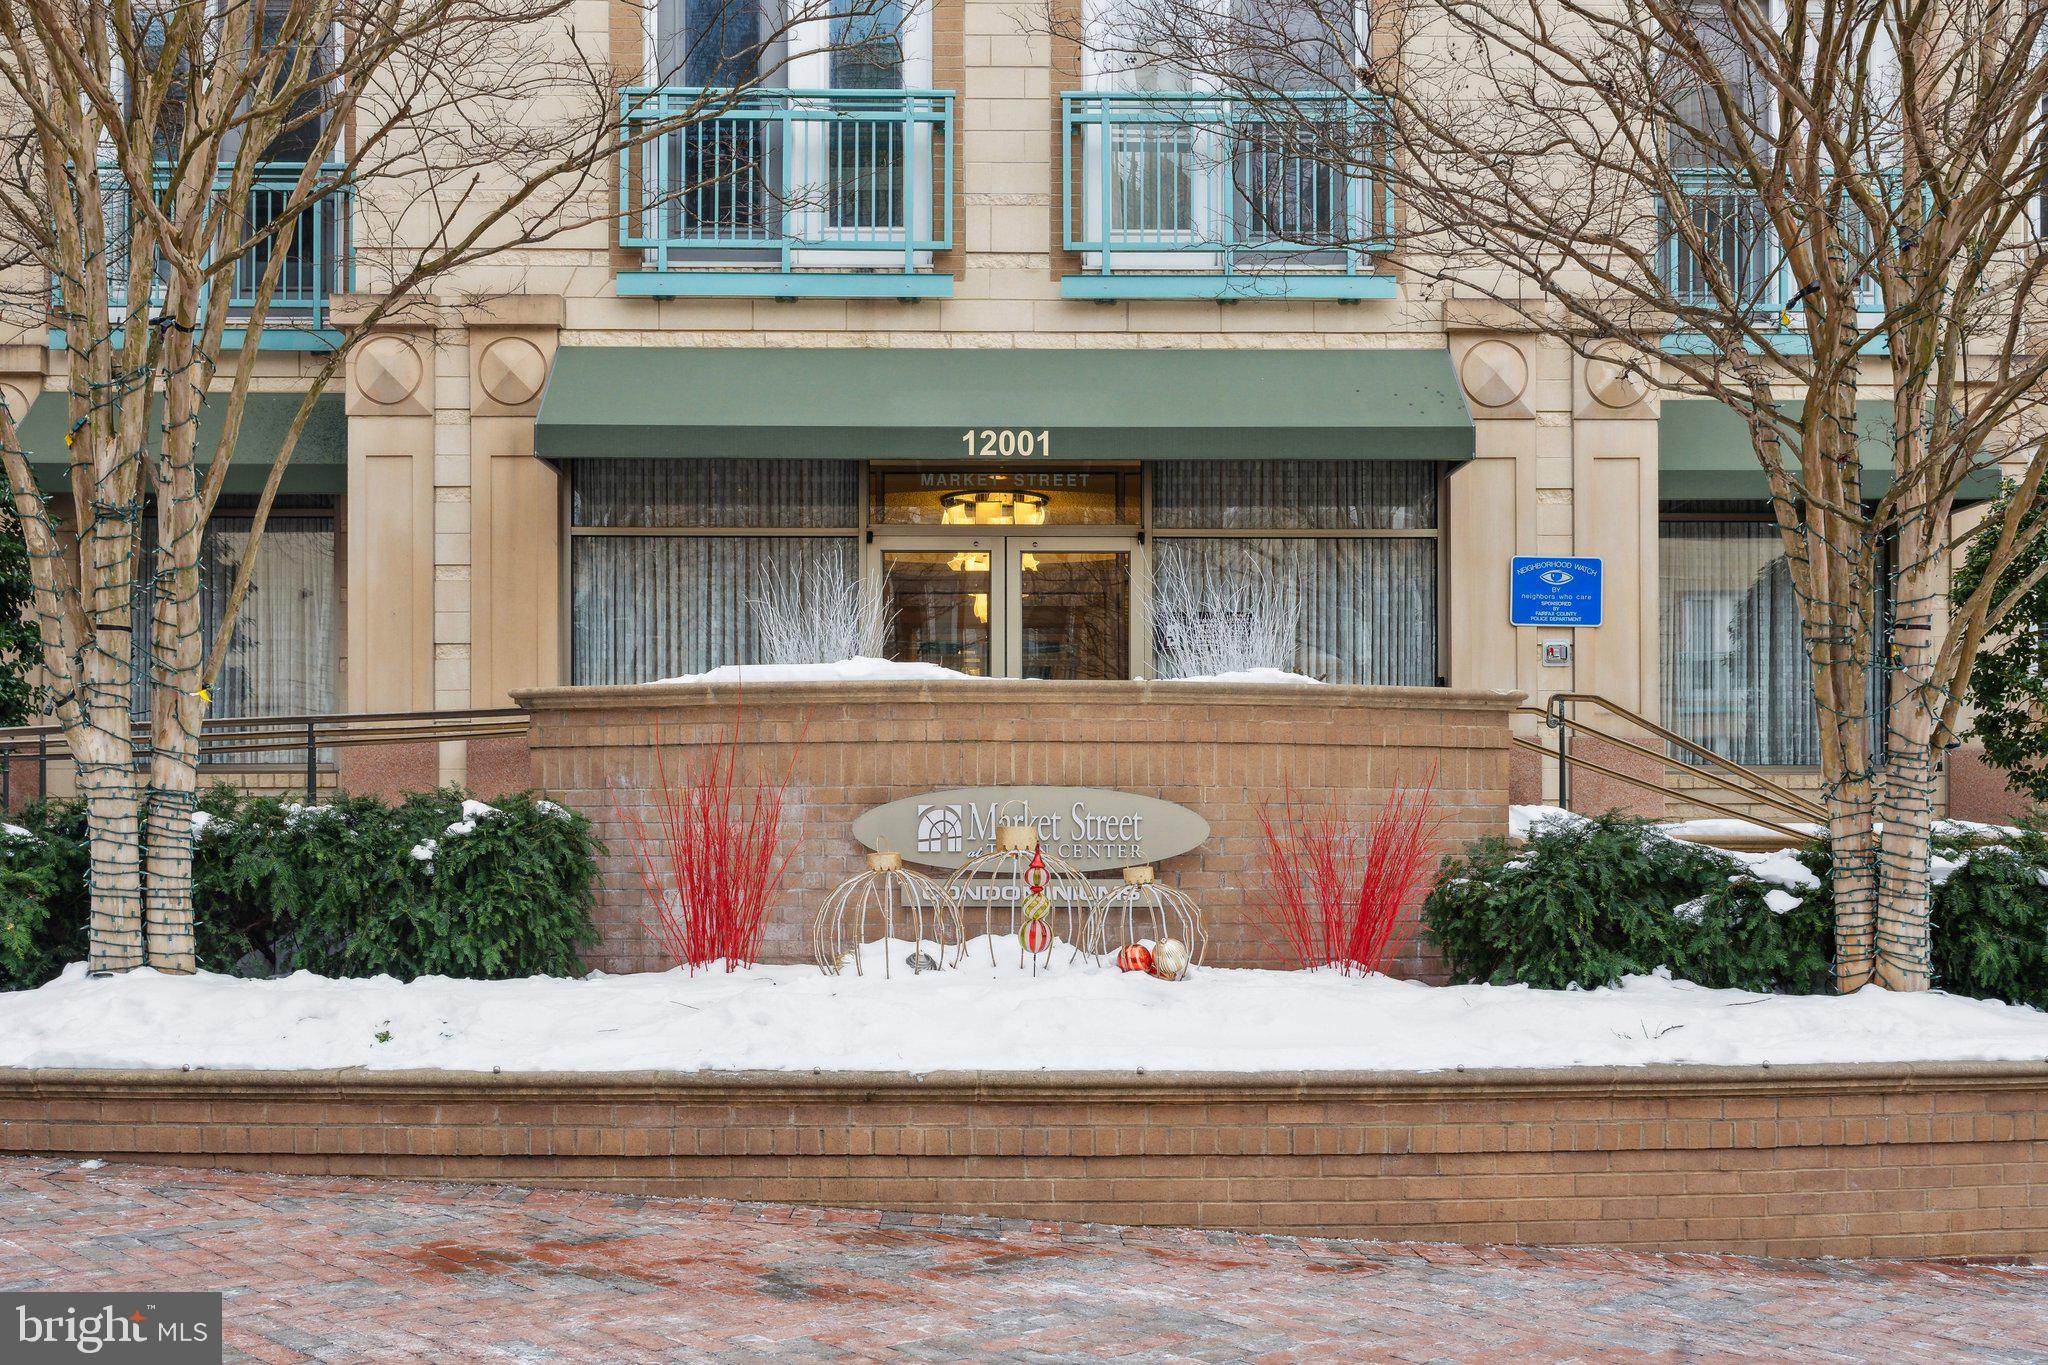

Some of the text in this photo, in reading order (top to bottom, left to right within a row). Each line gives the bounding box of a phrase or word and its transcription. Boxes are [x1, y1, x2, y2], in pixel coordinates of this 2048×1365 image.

[962, 430, 1049, 456] 12001
[920, 474, 1090, 487] MARKET STREET
[1516, 561, 1598, 577] NEIGHBORHOOD WATCH
[967, 800, 1142, 841] Market Street
[967, 843, 1142, 858] at TN CENTER
